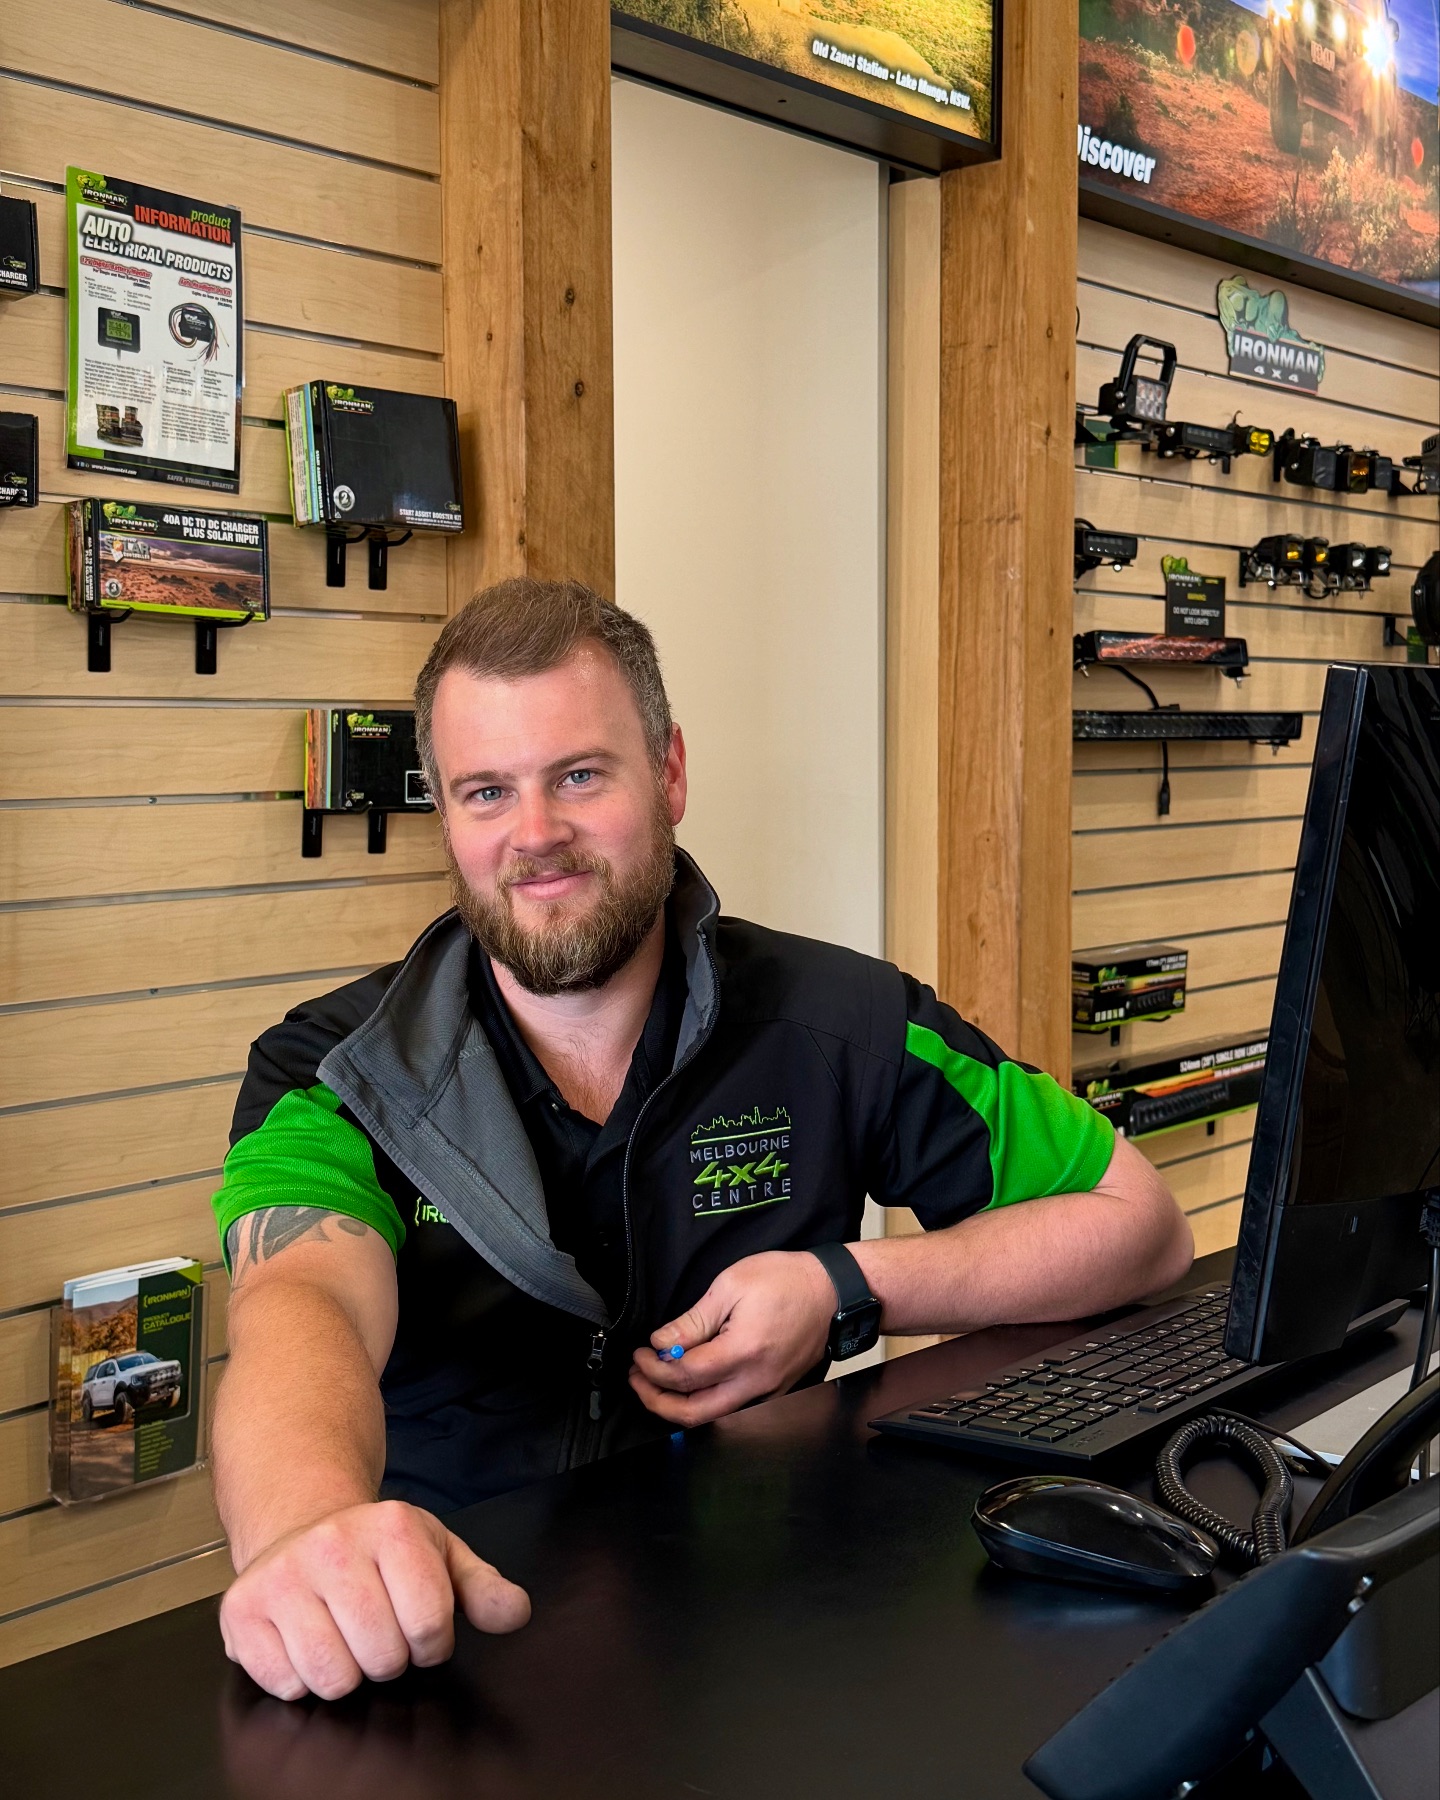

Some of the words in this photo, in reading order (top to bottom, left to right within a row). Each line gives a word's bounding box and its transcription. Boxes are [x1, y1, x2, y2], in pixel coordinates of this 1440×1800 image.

[813, 40, 828, 59] Old
[830, 46, 856, 68] Zanci
[856, 56, 889, 81] Station
[896, 70, 918, 91] Lake
[918, 77, 949, 105] Mungo,
[83, 188, 126, 203] IRONMAN
[83, 214, 132, 243] AUTO
[134, 205, 231, 245] INFORMATION
[191, 210, 231, 229] product
[85, 235, 163, 265] ELECTRICAL
[165, 252, 231, 281] PRODUCTS
[1234, 334, 1319, 375] IRONMAN
[341, 492, 349, 504] 2
[111, 517, 156, 528] IRONMAN
[163, 514, 180, 526] 40A
[181, 516, 194, 527] DC
[195, 518, 206, 529] TO
[208, 519, 219, 530] DC
[221, 521, 259, 534] CHARGER
[183, 528, 205, 539] PLUS
[207, 531, 234, 543] SOLAR
[235, 534, 260, 545] INPUT
[111, 583, 117, 593] 3
[1215, 1049, 1233, 1064] SINGLE
[1234, 1046, 1246, 1058] ROW
[690, 1135, 790, 1163] MELBOURNE
[692, 1178, 791, 1209] CENTRE
